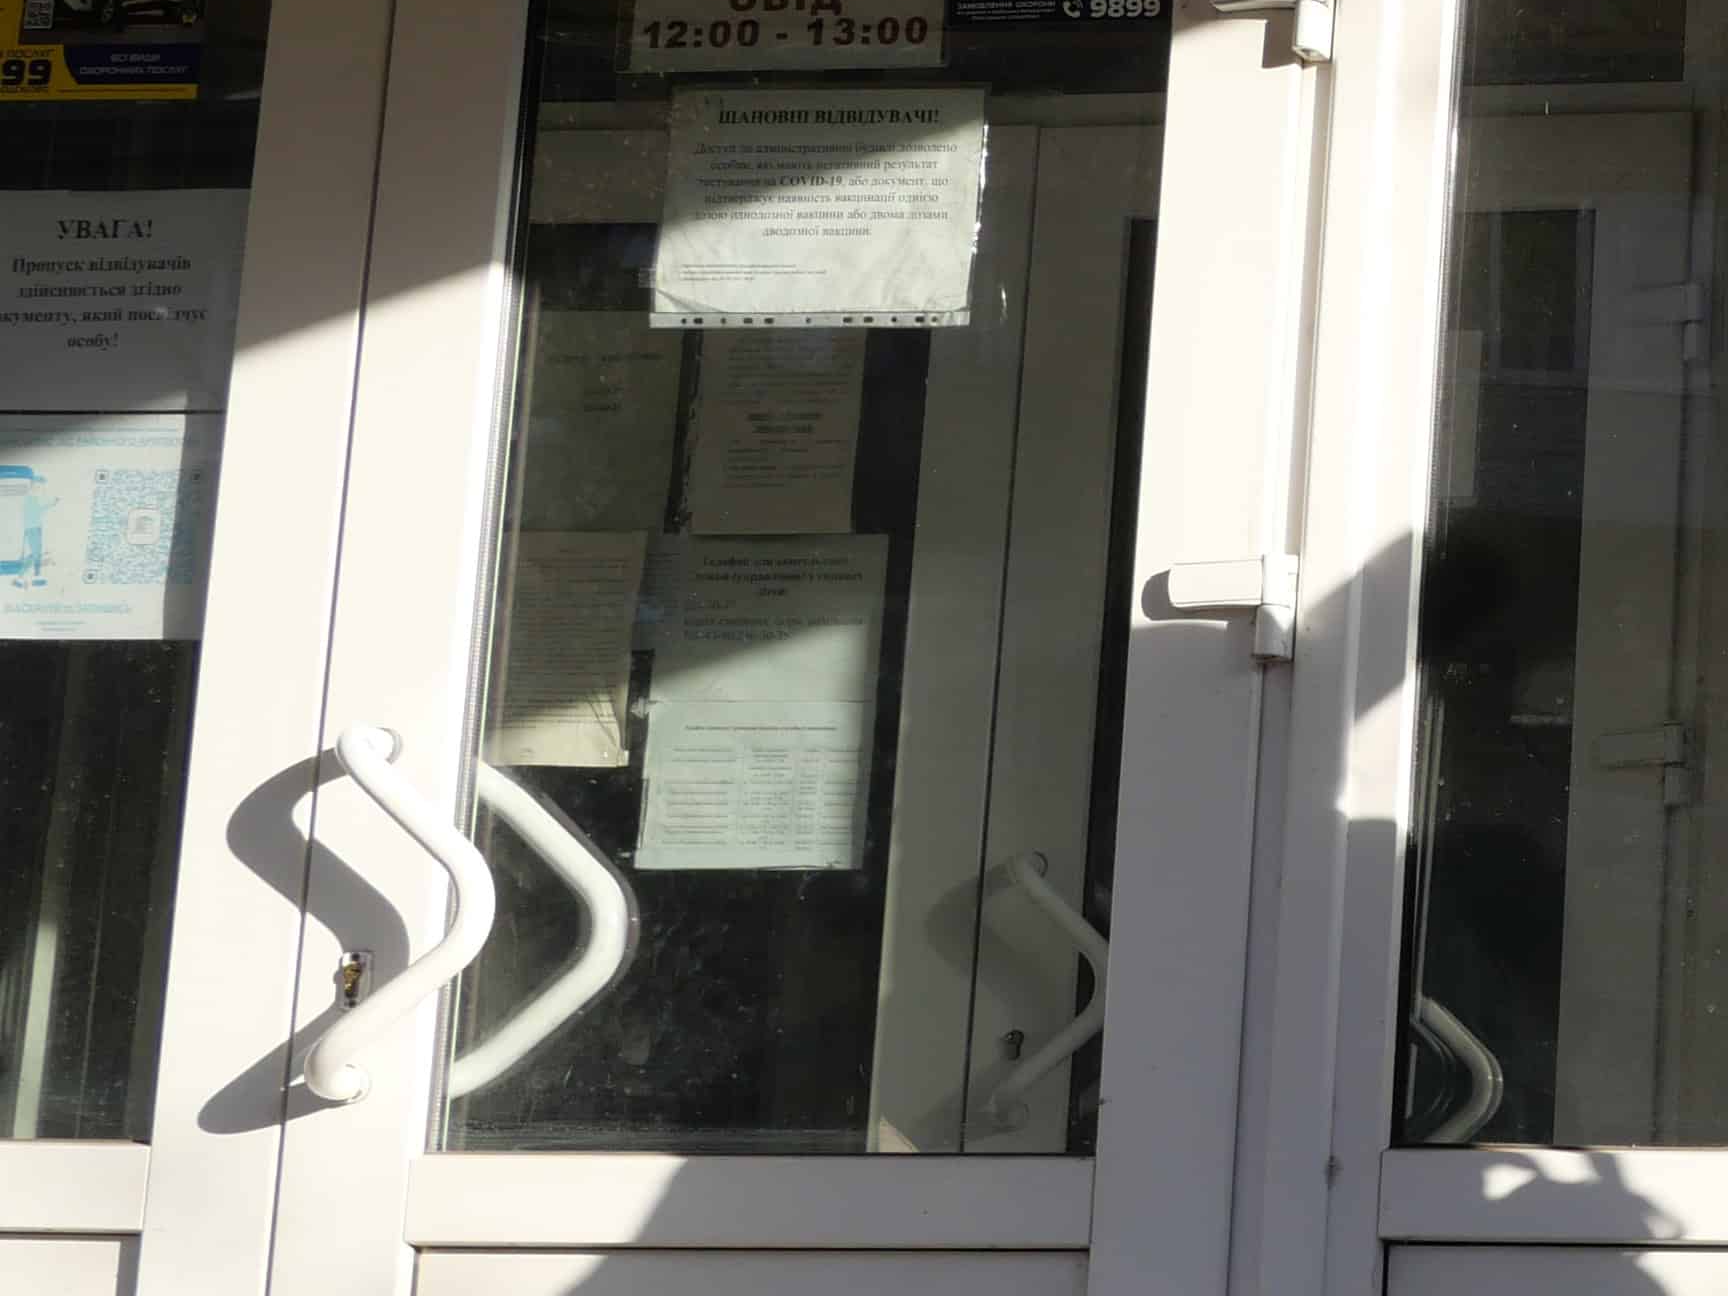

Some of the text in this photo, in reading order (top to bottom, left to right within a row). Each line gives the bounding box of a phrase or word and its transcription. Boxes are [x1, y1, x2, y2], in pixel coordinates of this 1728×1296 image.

[643, 19, 760, 49] 12:00
[806, 16, 929, 46] 13:00
[719, 108, 940, 124] ШАНОВНІ ВІДВІДУВАЧІ!
[57, 219, 153, 240] УВАГА!
[13, 255, 192, 276] Пропуск відвідувачів
[67, 332, 119, 351] особу!
